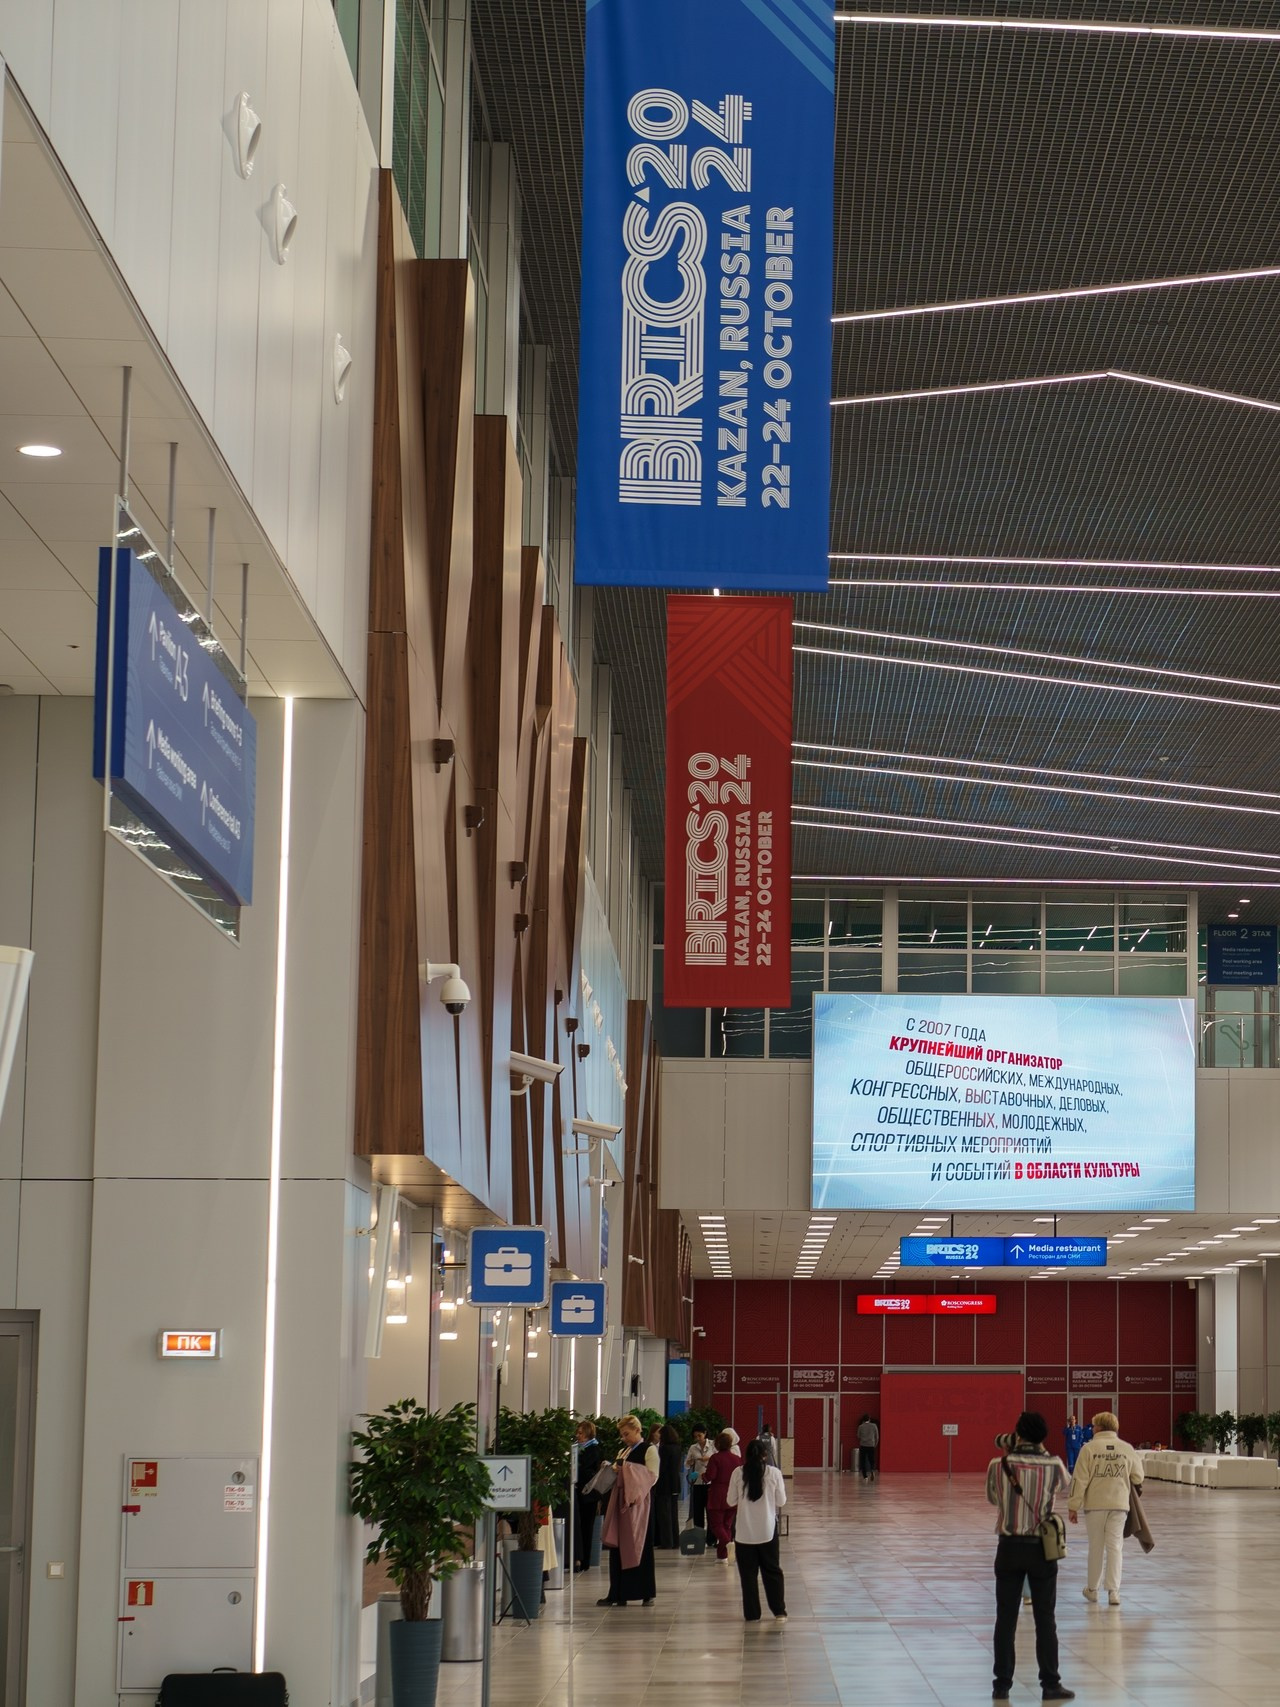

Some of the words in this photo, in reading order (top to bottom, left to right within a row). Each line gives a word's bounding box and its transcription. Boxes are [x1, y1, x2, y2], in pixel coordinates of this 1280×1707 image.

[691, 94, 752, 192] 24
[720, 204, 751, 351] RUSSIA
[763, 206, 794, 389] OCTOBER
[717, 360, 754, 507] KAZAN,
[761, 398, 791, 508] 22-24
[735, 810, 750, 886] RUSSIA
[757, 811, 773, 905] OCTOBER
[734, 890, 753, 966] KAZAN,
[1240, 928, 1248, 939] 2
[906, 1018, 915, 1031] С
[918, 1019, 951, 1036] 2007
[954, 1024, 986, 1043] ГОДА
[889, 1036, 983, 1061] КРУПНЕЙШИЙ
[986, 1049, 1063, 1071] ОРГАНИЗАТОР
[850, 1078, 961, 1104] КОНГРЕССНЫХ,
[965, 1088, 1057, 1111] ВЫСТАВОЧНЫХ,
[1059, 1096, 1110, 1115] ДЕЛОВЫХ,
[905, 1060, 1026, 1088] ОБЩЕРОССИЙСКИХ,
[1028, 1074, 1124, 1097] МЕЖДУНАРОДНЫХ,
[877, 1106, 998, 1131] ОБЩЕСТВЕННЫХ,
[1001, 1113, 1088, 1134] МОЛОДЕЖНЫХ,
[851, 1133, 957, 1153] СПОРТИВНЫХ
[960, 1134, 1052, 1154] МЕРОПРИЯТИЙ
[930, 1163, 942, 1181] И
[946, 1159, 1011, 1181] СОБЫТИЙ
[1015, 1162, 1023, 1180] В
[1026, 1162, 1082, 1180] ОБЛАСТИ
[1084, 1162, 1140, 1178] КУЛЬТУРЫ
[177, 1336, 202, 1350] ПК
[1175, 1371, 1196, 1379] BRI
[1094, 1464, 1125, 1477] LAX
